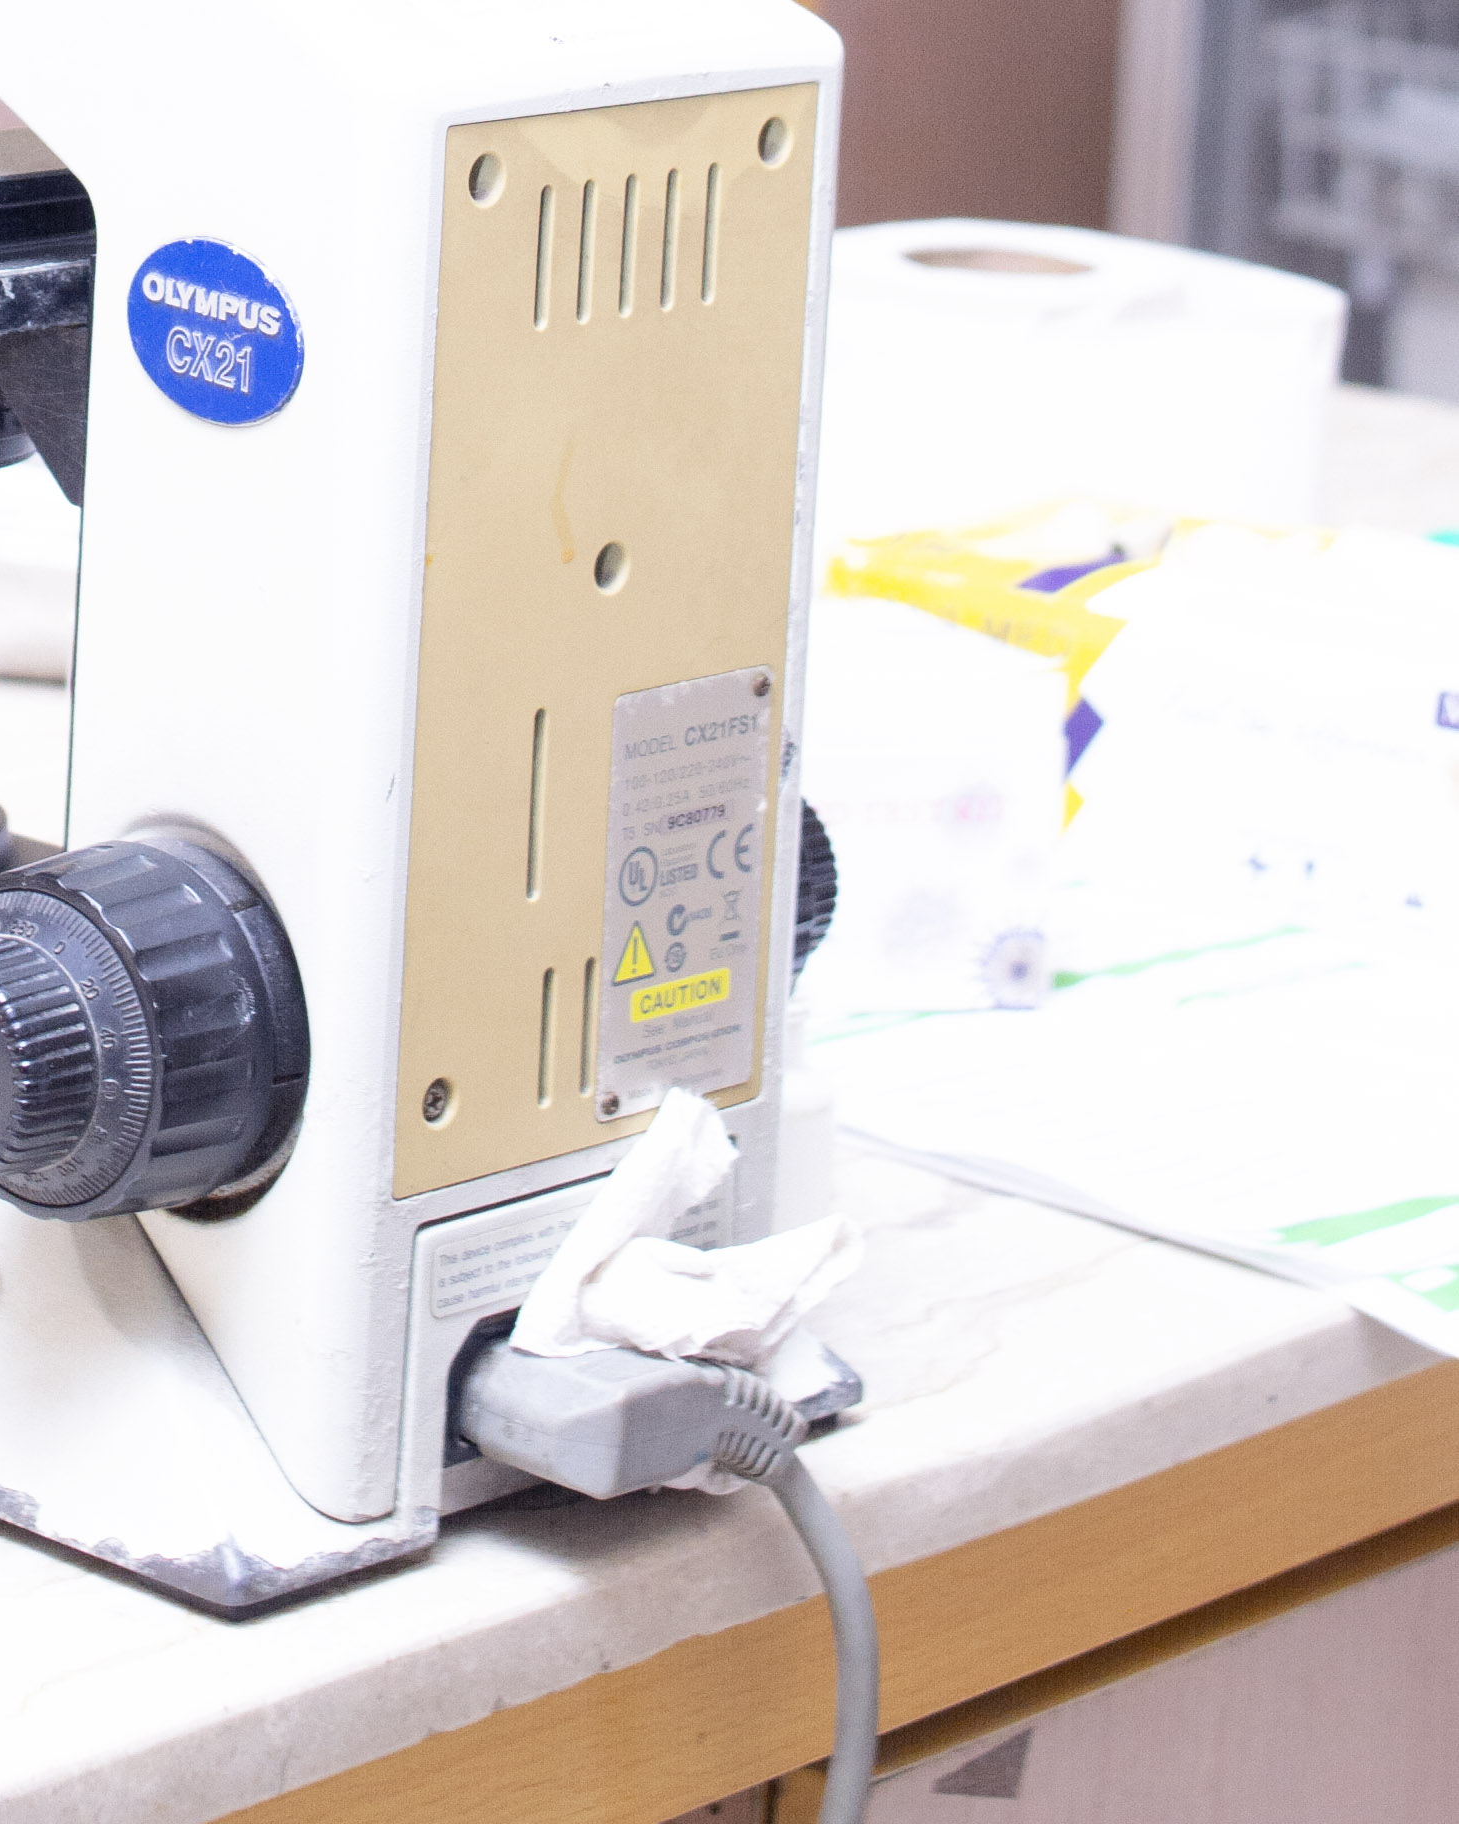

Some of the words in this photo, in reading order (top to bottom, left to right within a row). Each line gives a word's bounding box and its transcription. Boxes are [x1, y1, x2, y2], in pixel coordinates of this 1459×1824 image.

[142, 272, 282, 336] OLYMPUS
[166, 325, 252, 394] CX21
[624, 734, 677, 760] MODEL
[684, 713, 758, 746] CX21FS1
[80, 976, 100, 1001] 20
[639, 976, 723, 1014] CAUTION
